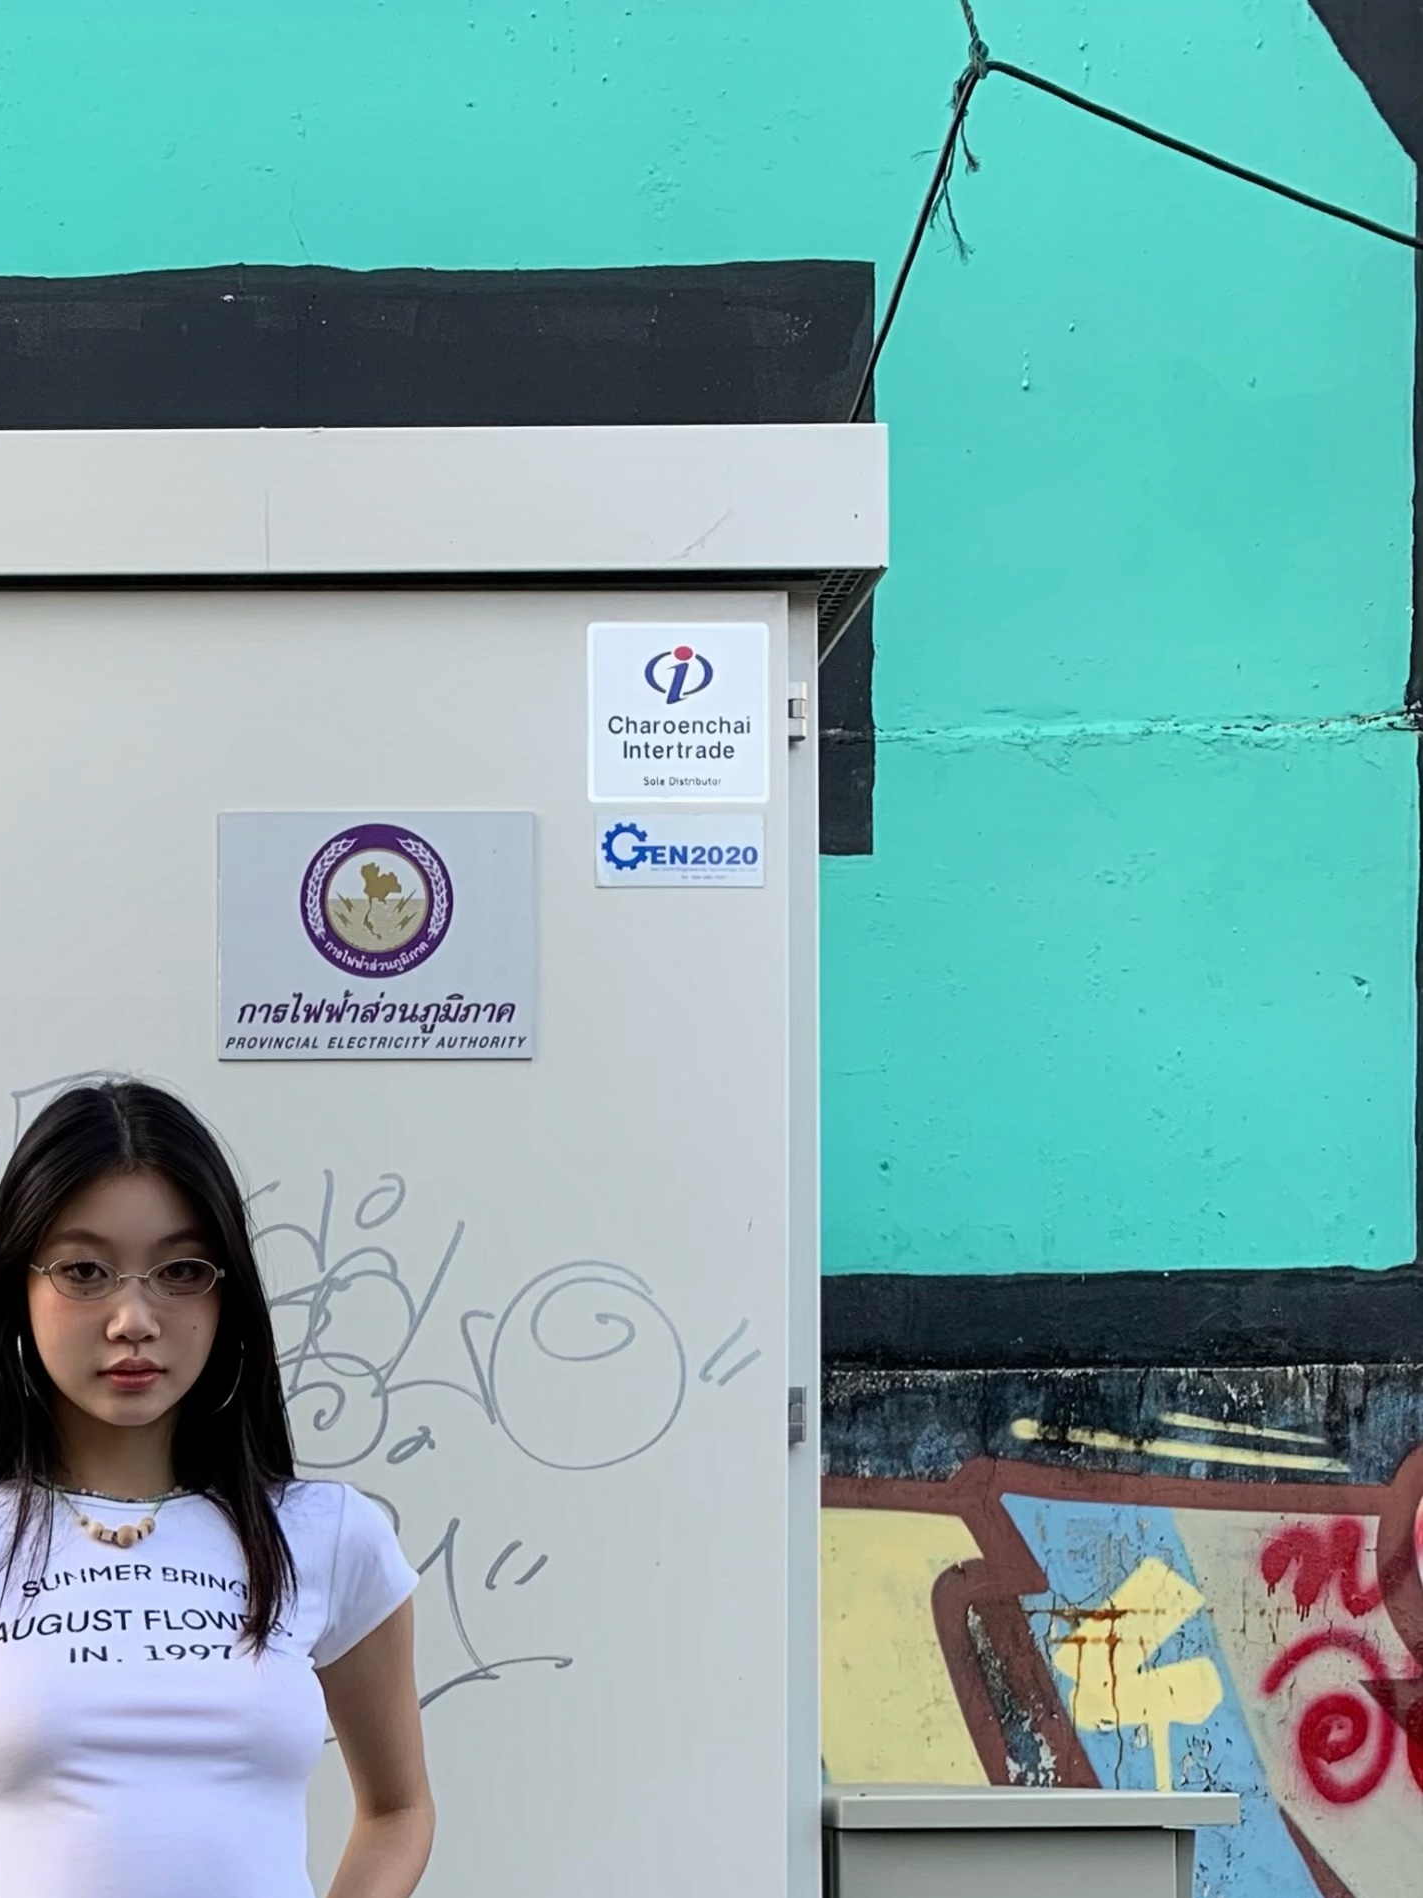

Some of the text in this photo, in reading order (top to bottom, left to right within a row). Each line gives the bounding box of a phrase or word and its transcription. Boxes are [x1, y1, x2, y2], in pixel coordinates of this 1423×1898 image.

[608, 716, 752, 735] Charoenchai
[623, 741, 736, 760] Intertrade
[643, 776, 722, 787] Sole Distributor
[236, 990, 516, 1034] การไฟฟ้าส่วนภูมิภาค
[225, 1036, 527, 1049] PROVINCIAL ELECTRICITY AUTHORITY
[143, 1644, 232, 1661] 1997
